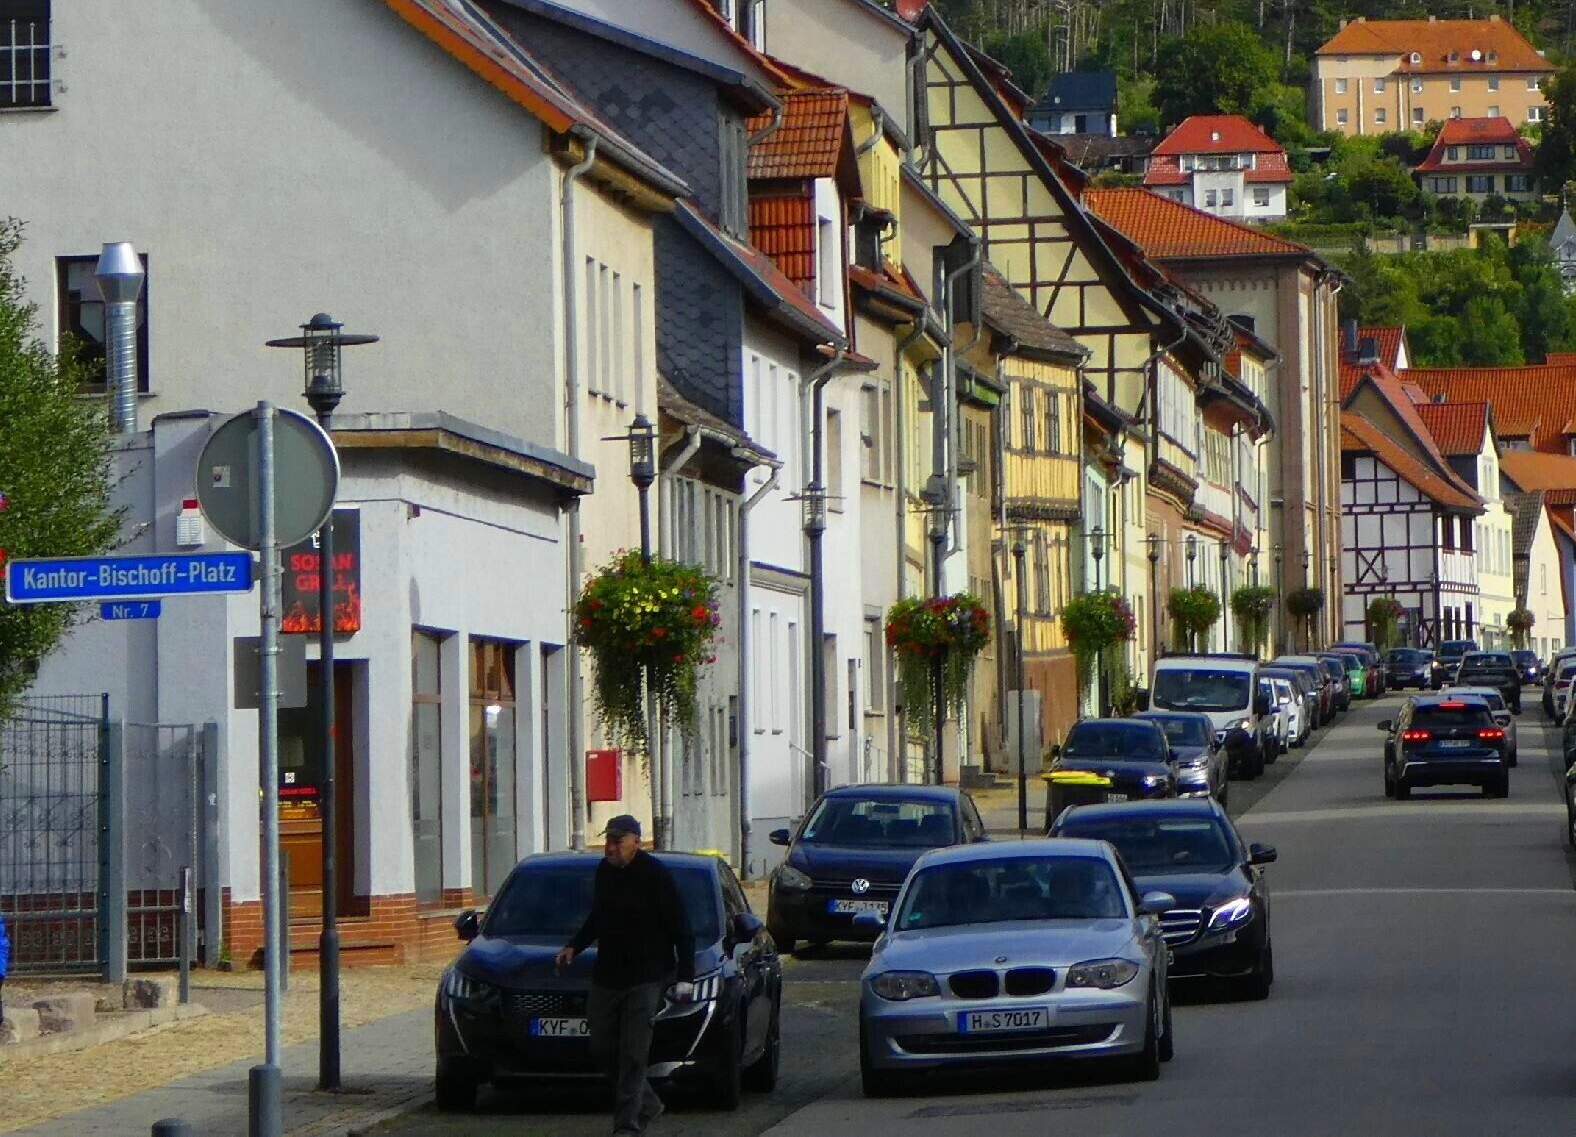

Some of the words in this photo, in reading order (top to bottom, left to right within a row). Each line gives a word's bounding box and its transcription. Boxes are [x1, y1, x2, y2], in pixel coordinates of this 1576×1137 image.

[23, 561, 236, 590] Kantor-Bischoff-Platz
[112, 605, 134, 619] Nr.
[140, 604, 149, 618] 7
[540, 1019, 568, 1035] KYF
[972, 1014, 982, 1029] H
